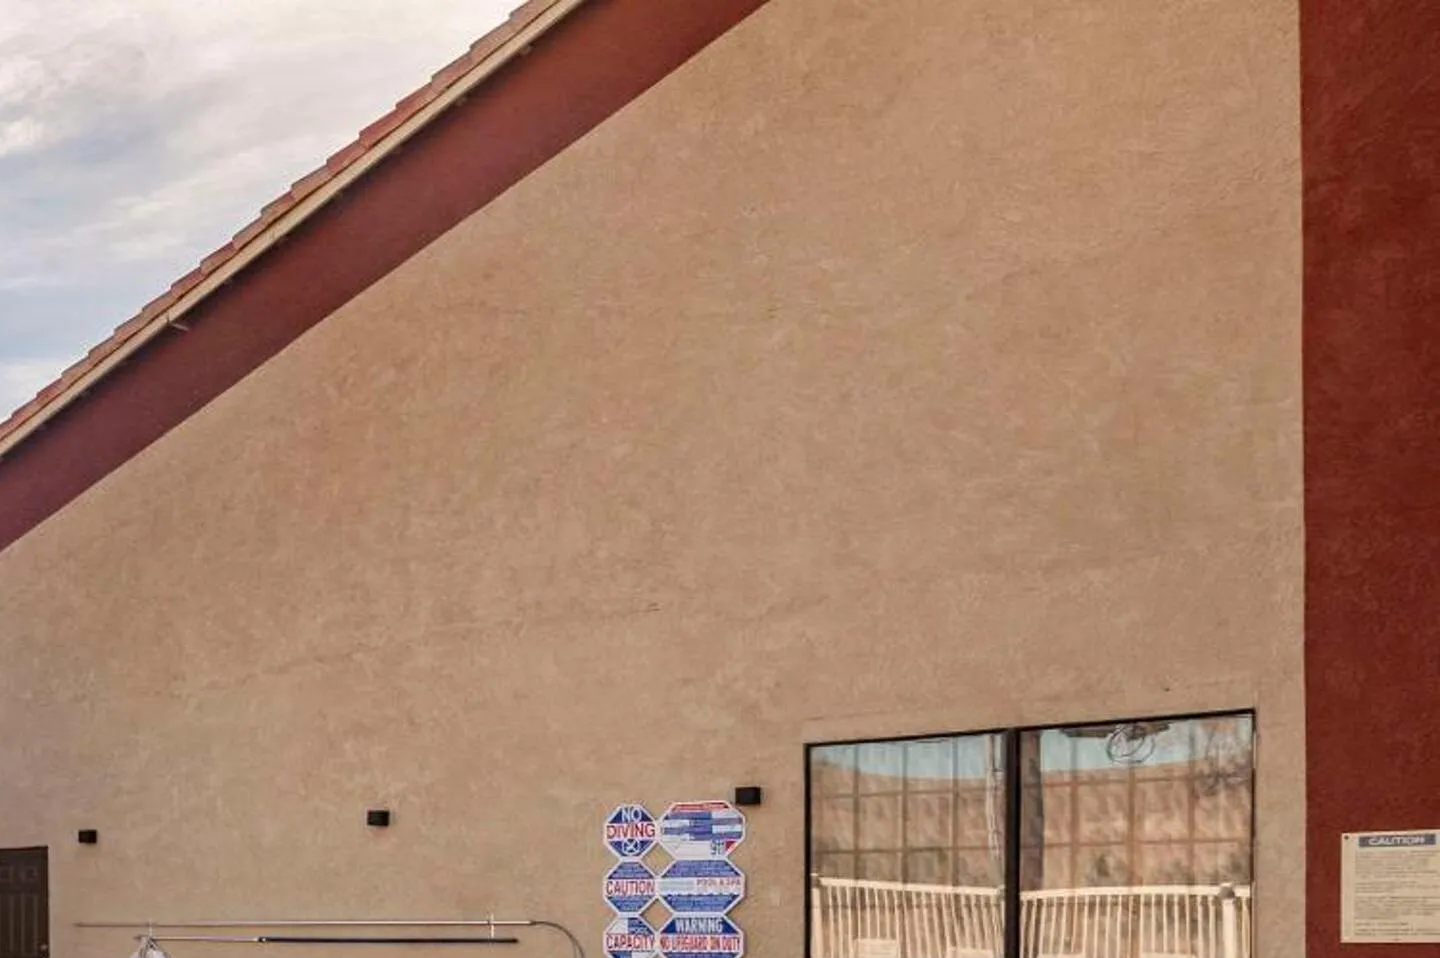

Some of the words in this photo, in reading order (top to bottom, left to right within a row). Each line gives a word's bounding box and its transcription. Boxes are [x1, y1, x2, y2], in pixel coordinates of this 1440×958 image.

[621, 807, 642, 822] NO
[606, 823, 655, 839] DIVING
[1368, 836, 1425, 846] CAUTION
[606, 881, 655, 895] CAUTION
[675, 917, 723, 933] WARNING
[606, 934, 654, 949] CAPACITY
[722, 935, 741, 950] DUTY
